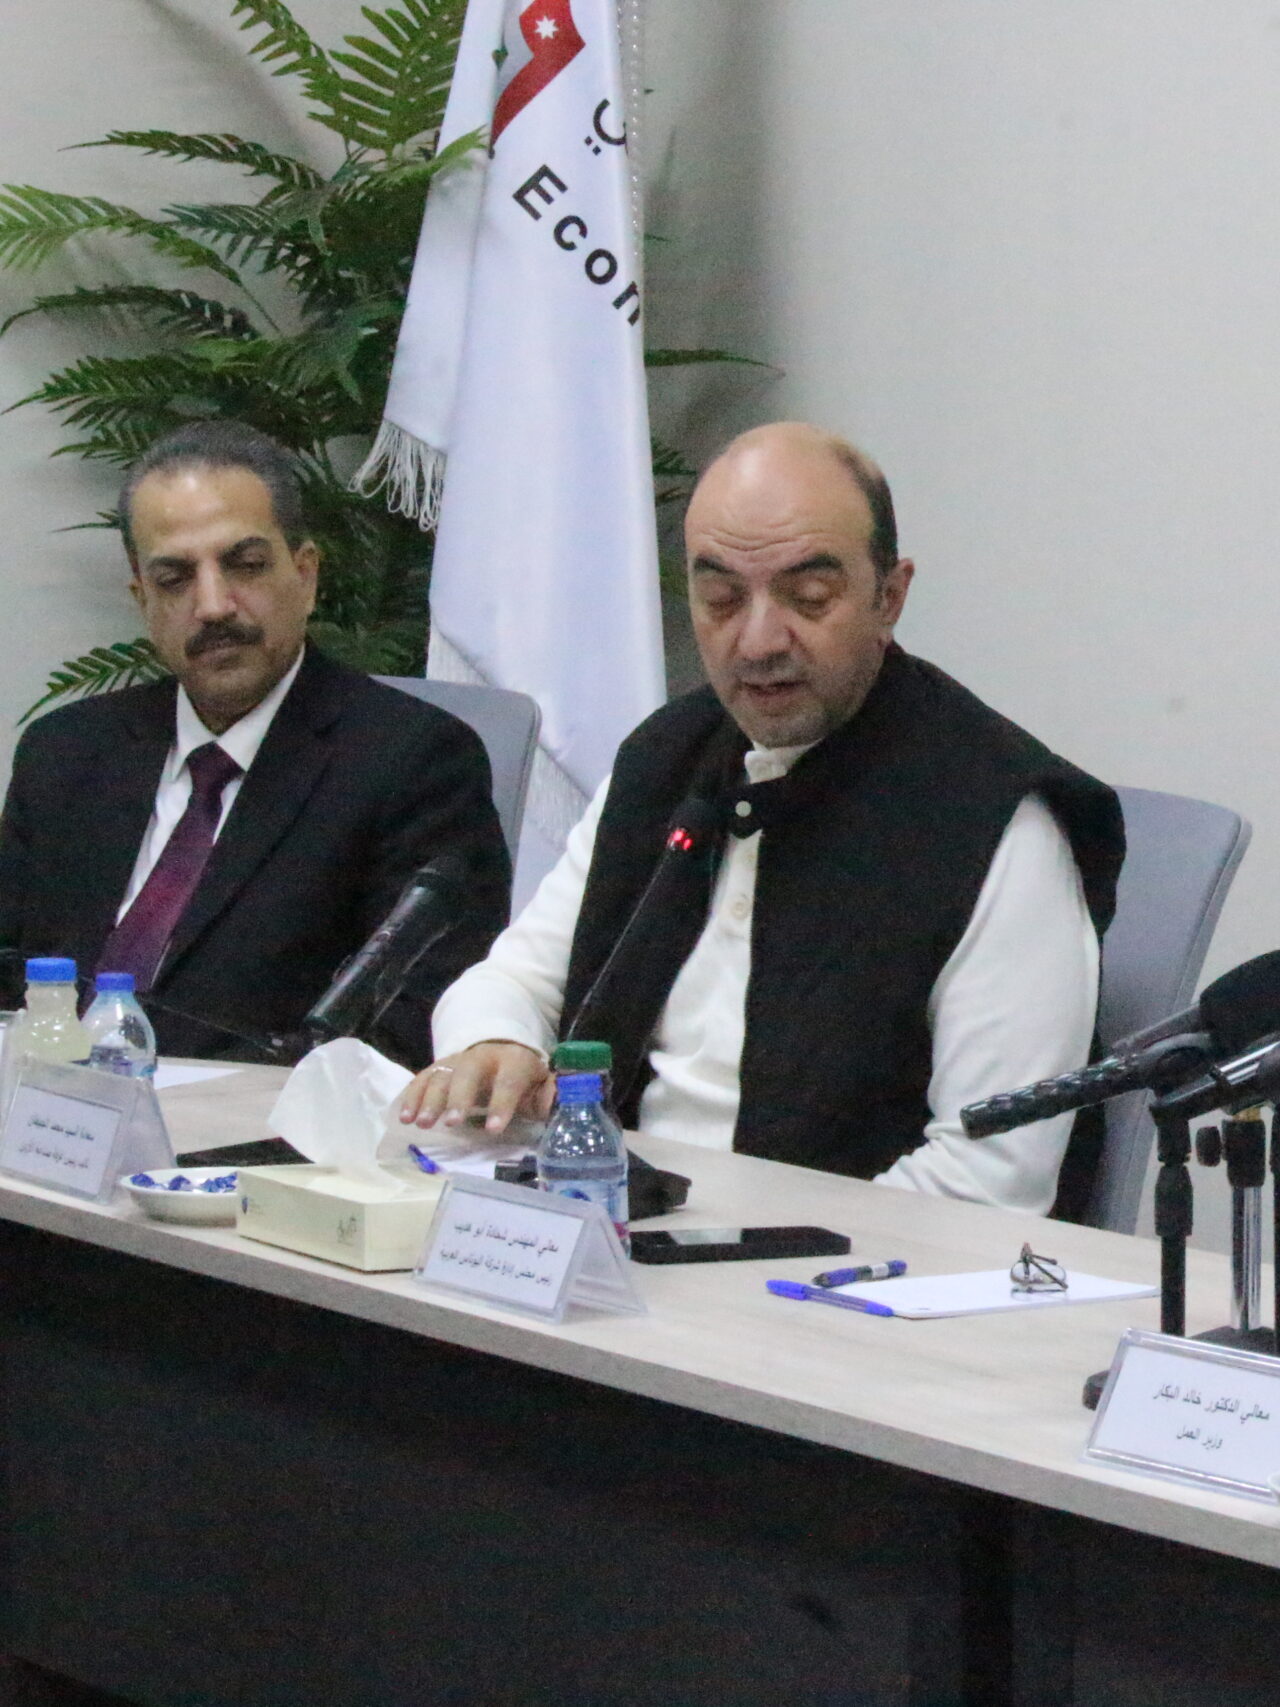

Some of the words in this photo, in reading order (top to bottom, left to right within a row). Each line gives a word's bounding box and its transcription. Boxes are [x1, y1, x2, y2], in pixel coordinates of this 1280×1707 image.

[1182, 1388, 1202, 1405] خالد
[1204, 1397, 1240, 1413] الدكتور
[1240, 1403, 1270, 1424] معالي
[1176, 1426, 1200, 1440] العمل
[1202, 1433, 1223, 1450] وزير
